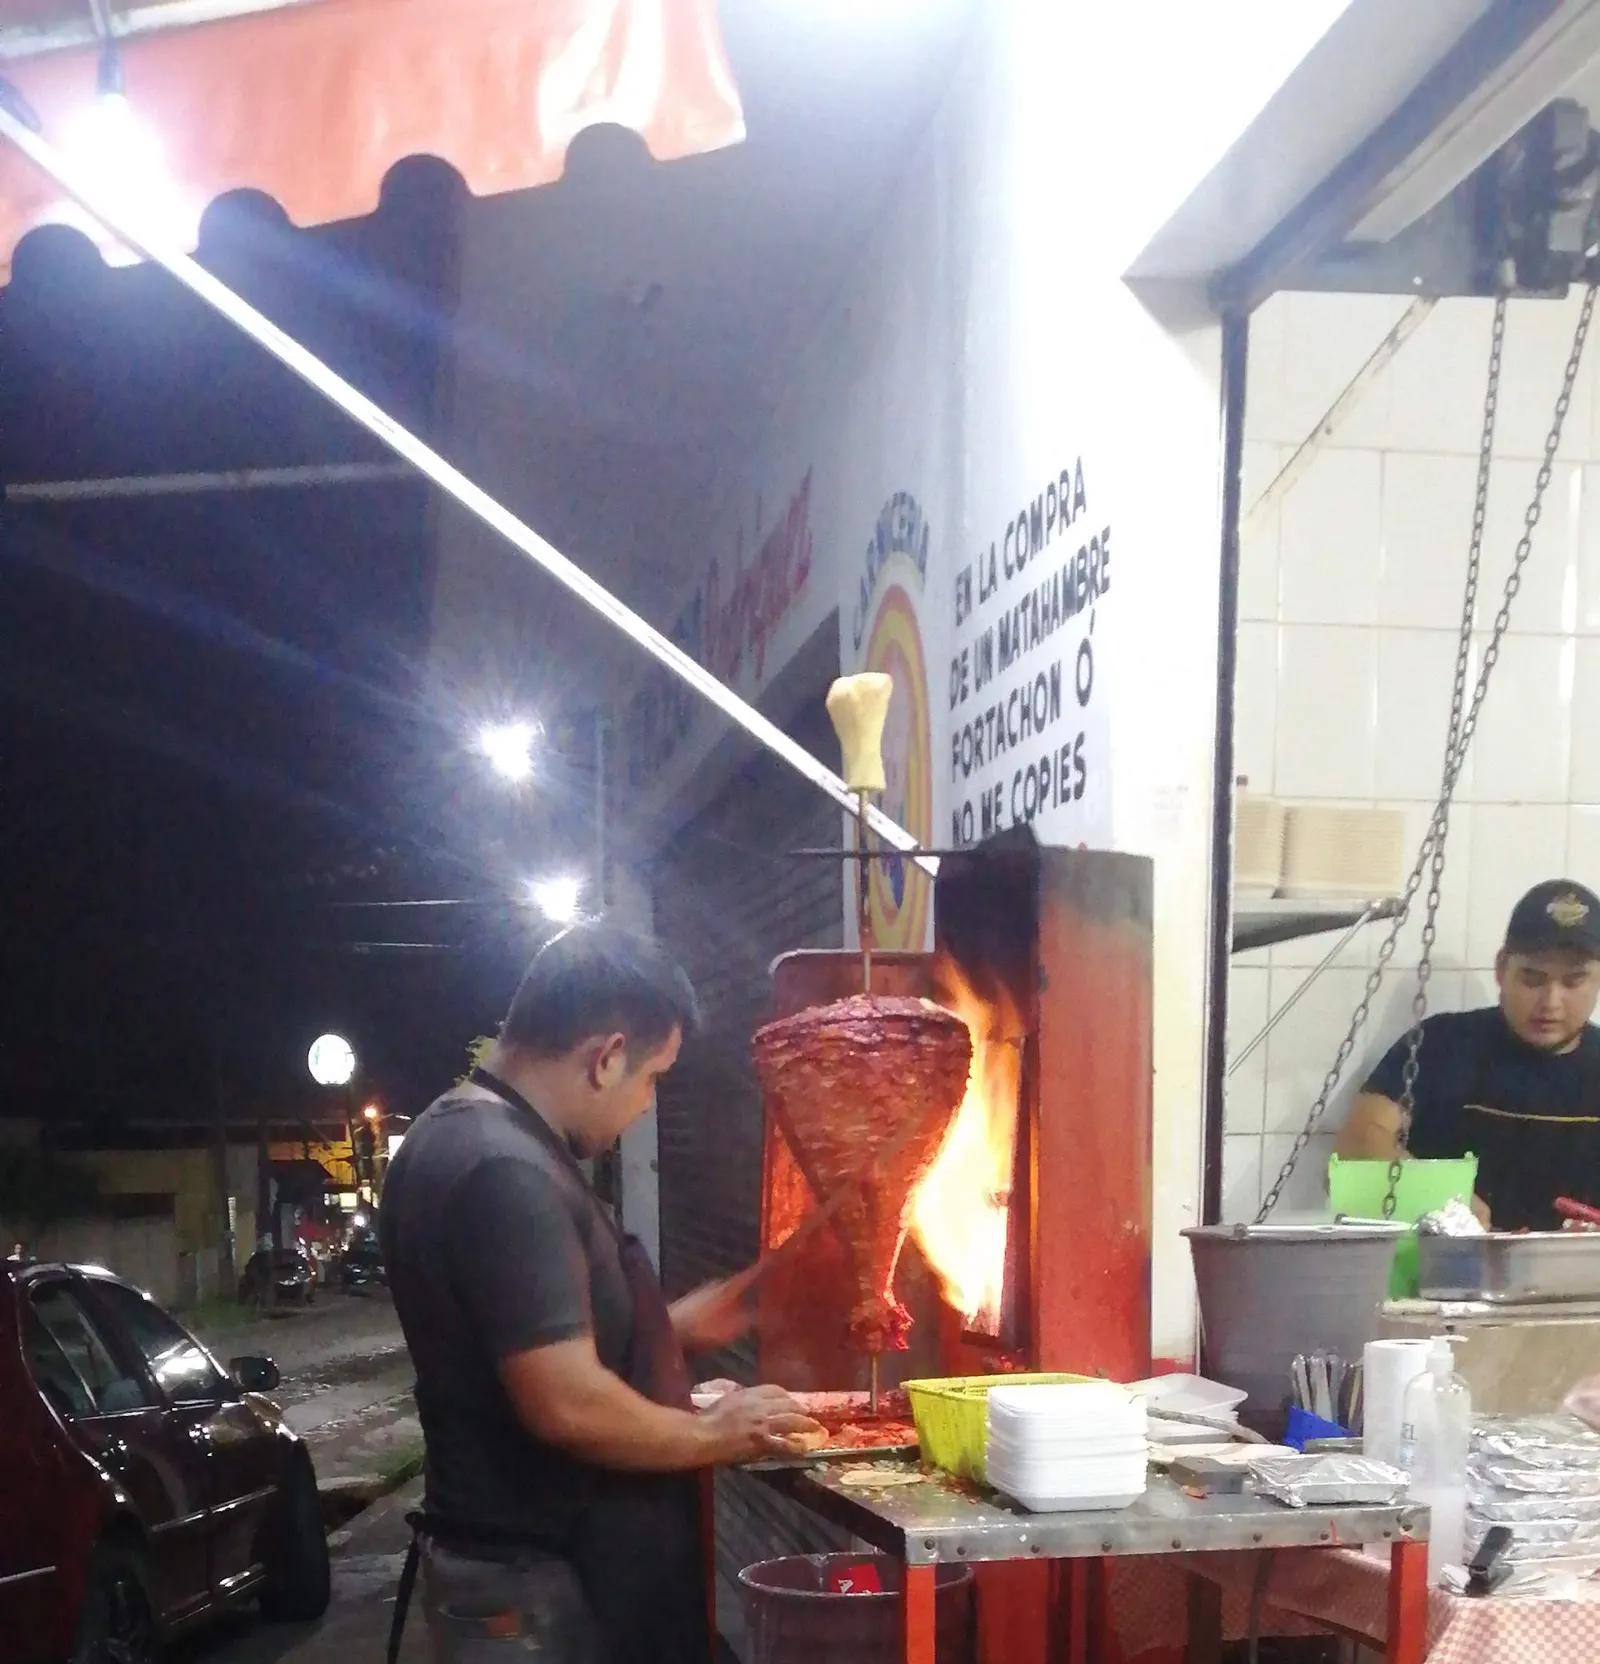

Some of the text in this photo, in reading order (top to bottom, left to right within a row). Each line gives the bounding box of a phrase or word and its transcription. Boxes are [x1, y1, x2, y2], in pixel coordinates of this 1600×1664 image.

[956, 455, 1088, 627] EN LA COMPRA
[949, 525, 1111, 712] DE UN MATAHAMBRE
[951, 659, 1062, 784] FORTACHON
[951, 730, 1087, 847] NO ME COPIES
